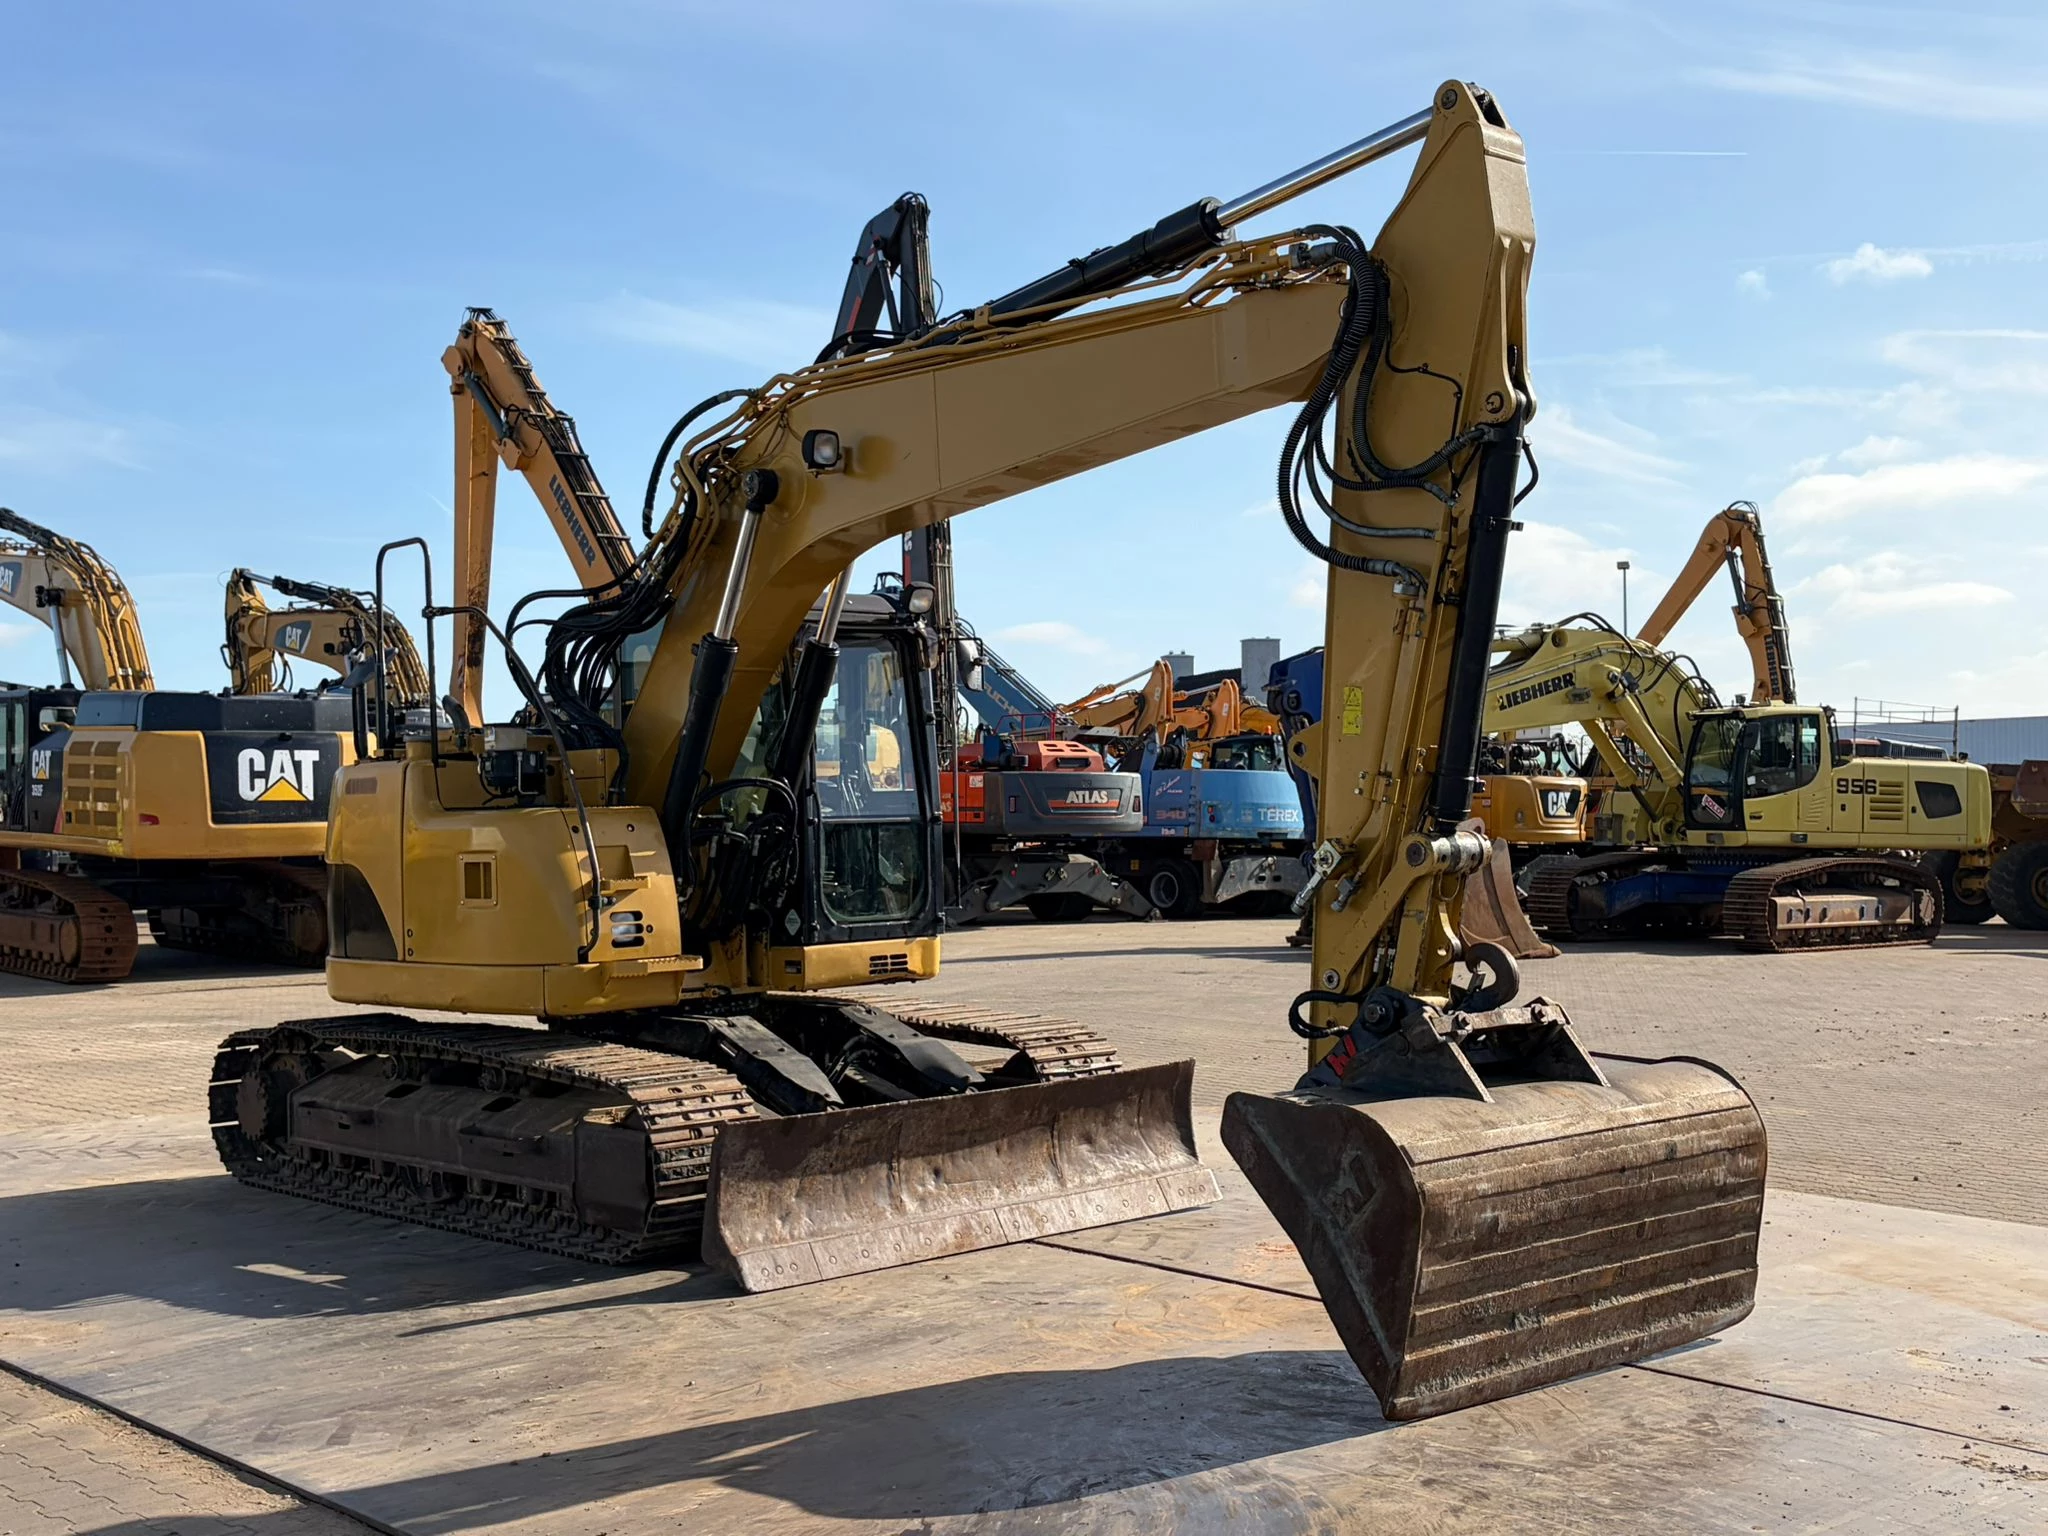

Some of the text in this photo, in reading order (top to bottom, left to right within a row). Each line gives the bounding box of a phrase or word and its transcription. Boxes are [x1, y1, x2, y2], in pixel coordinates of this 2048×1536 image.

[549, 474, 596, 568] LIEBHERR
[285, 625, 302, 650] CAT
[1497, 672, 1576, 711] LIEBHERR
[31, 748, 52, 780] CAT
[237, 748, 320, 802] CAT
[1065, 790, 1109, 804] ATLAS
[1836, 777, 1877, 795] 956
[1257, 808, 1300, 823] TEREX
